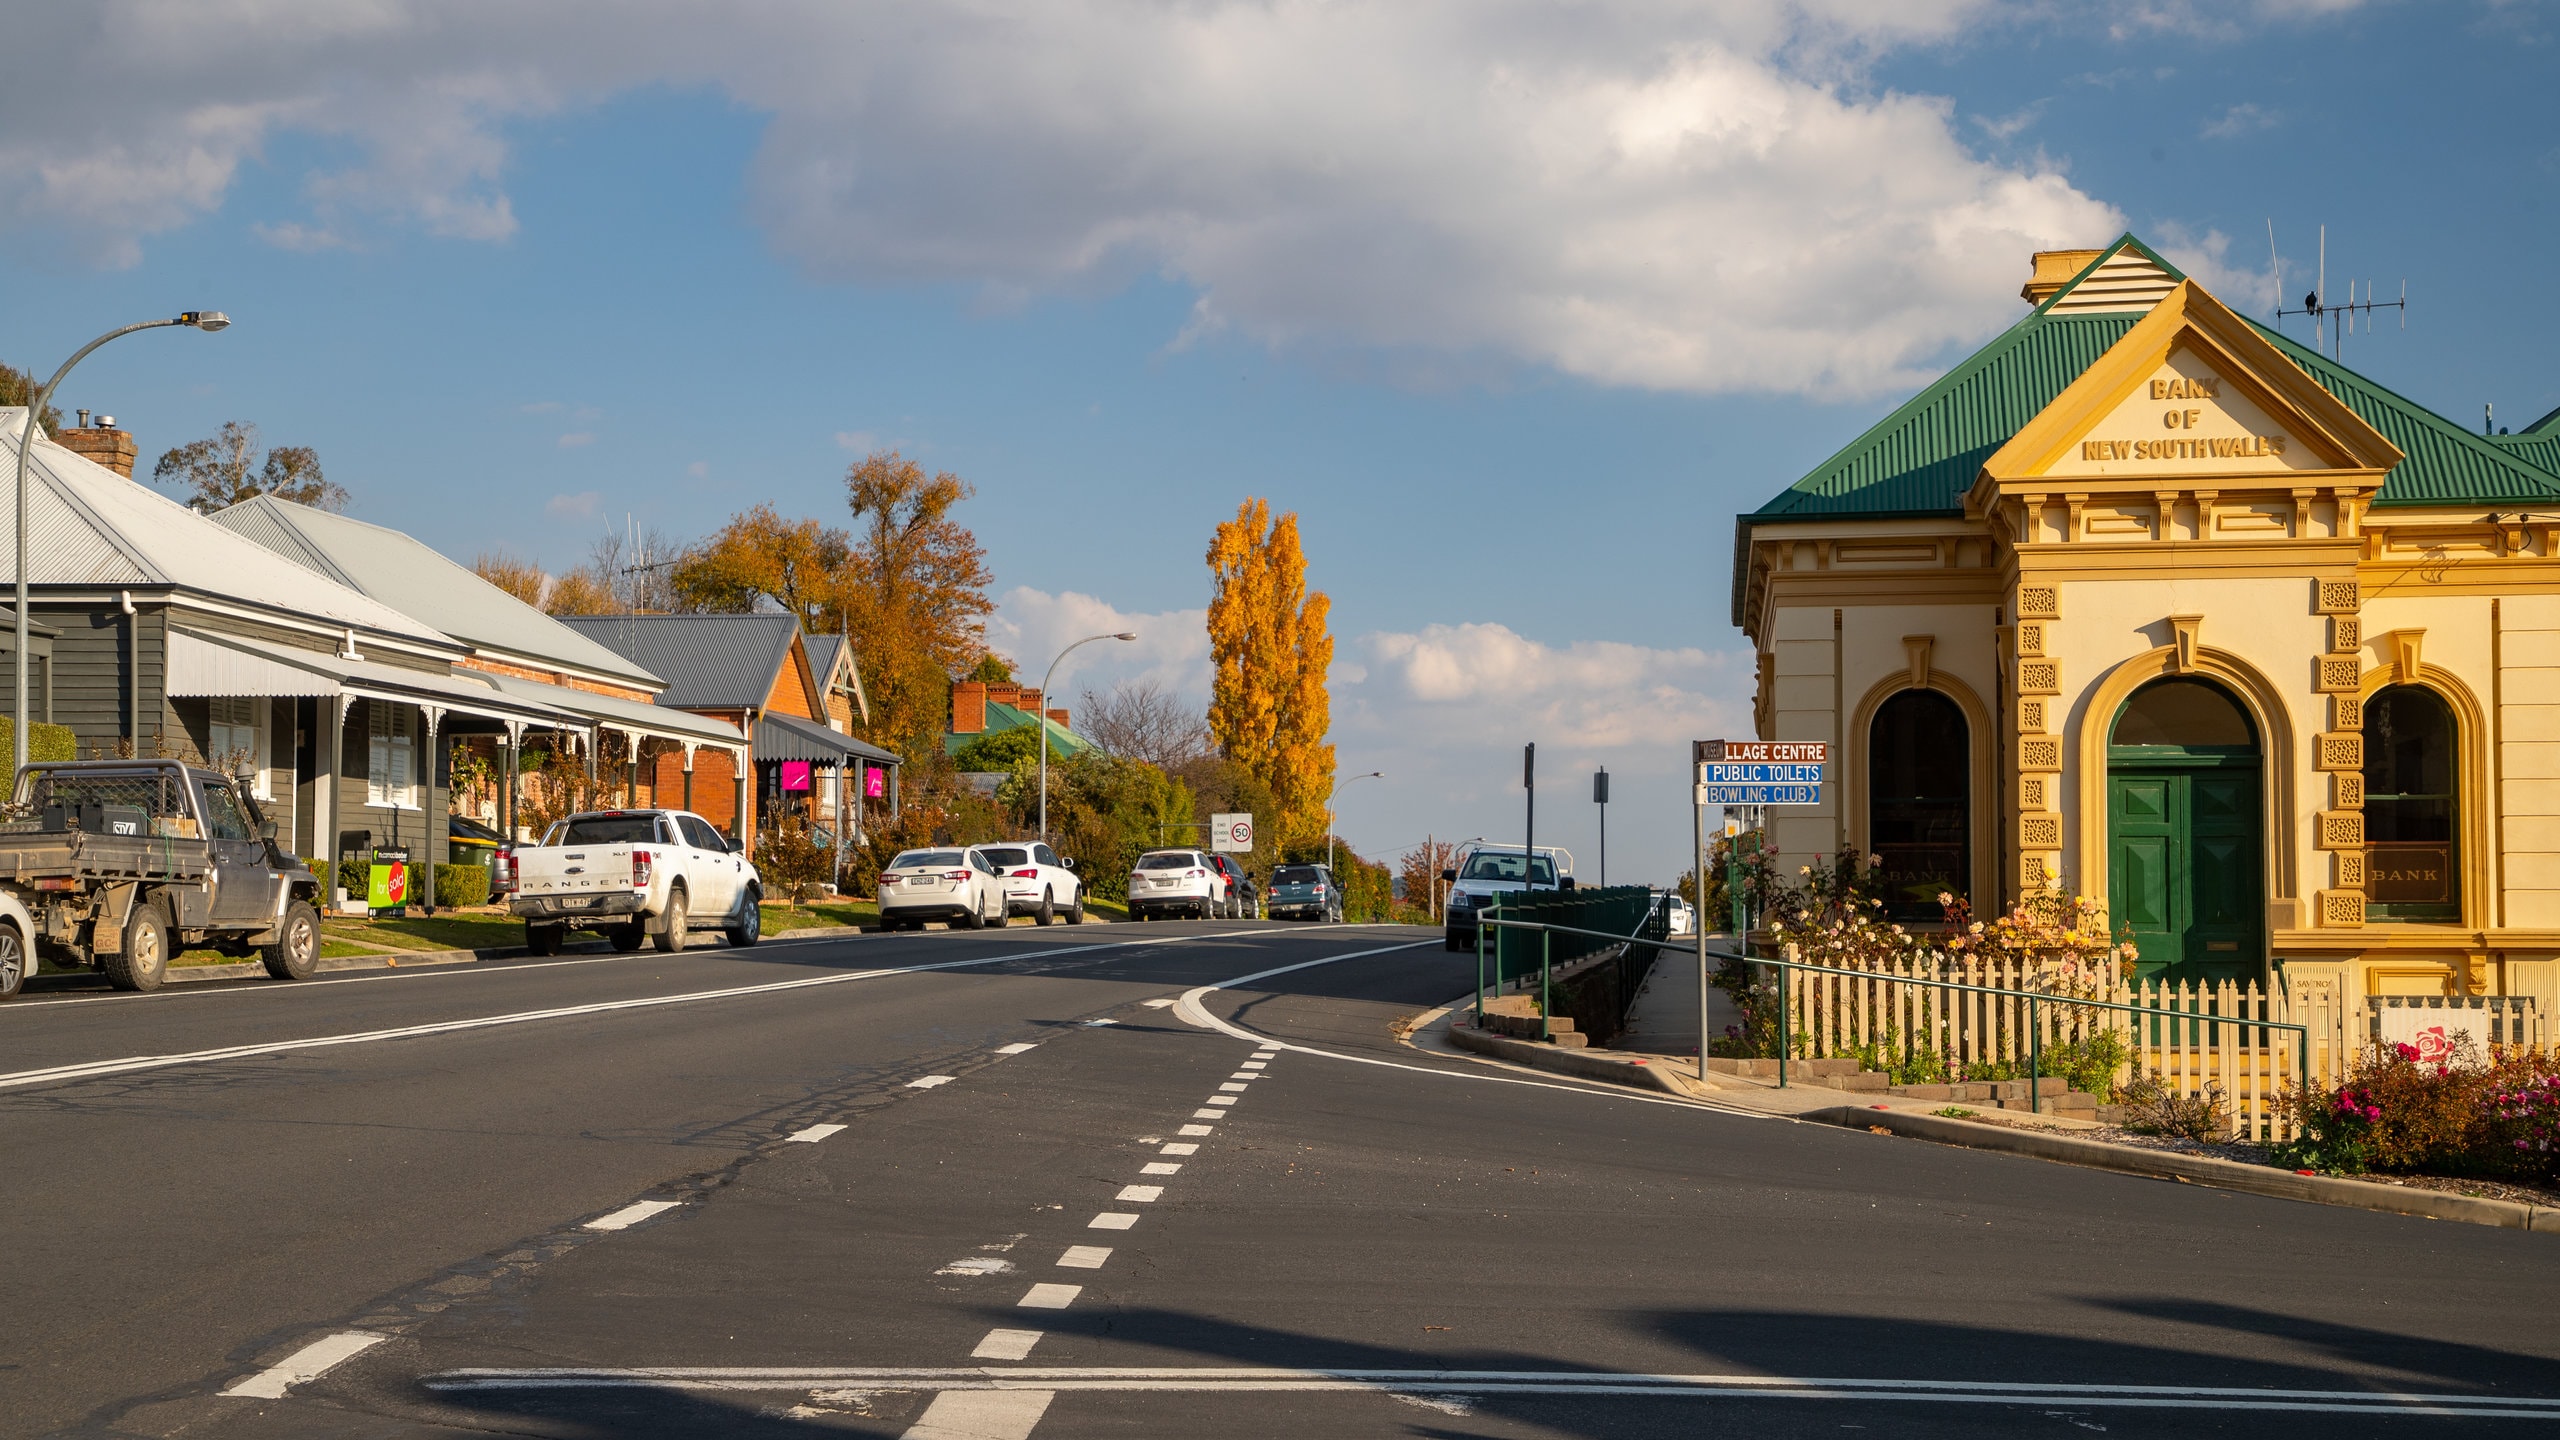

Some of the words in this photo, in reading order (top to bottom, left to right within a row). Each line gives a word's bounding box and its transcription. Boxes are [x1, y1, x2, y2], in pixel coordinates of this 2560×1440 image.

[2150, 378, 2221, 400] BANK
[2164, 408, 2201, 429] OF
[2082, 440, 2132, 461] NEW
[2134, 438, 2208, 460] SOUTH
[2208, 435, 2287, 458] WALES
[1726, 745, 1768, 760] LLAGE
[1773, 745, 1824, 760] CENTRE
[1713, 766, 1761, 781] PUBLIC
[1768, 765, 1819, 780] TOILETS
[1710, 787, 1766, 802] BOWLING
[1774, 787, 1807, 801] CLUB
[1235, 828, 1248, 837] 50
[390, 872, 404, 891] sold
[1889, 871, 1950, 881] BANK
[2371, 870, 2438, 881] BANK
[377, 882, 385, 894] for
[524, 879, 629, 889] RANGER
